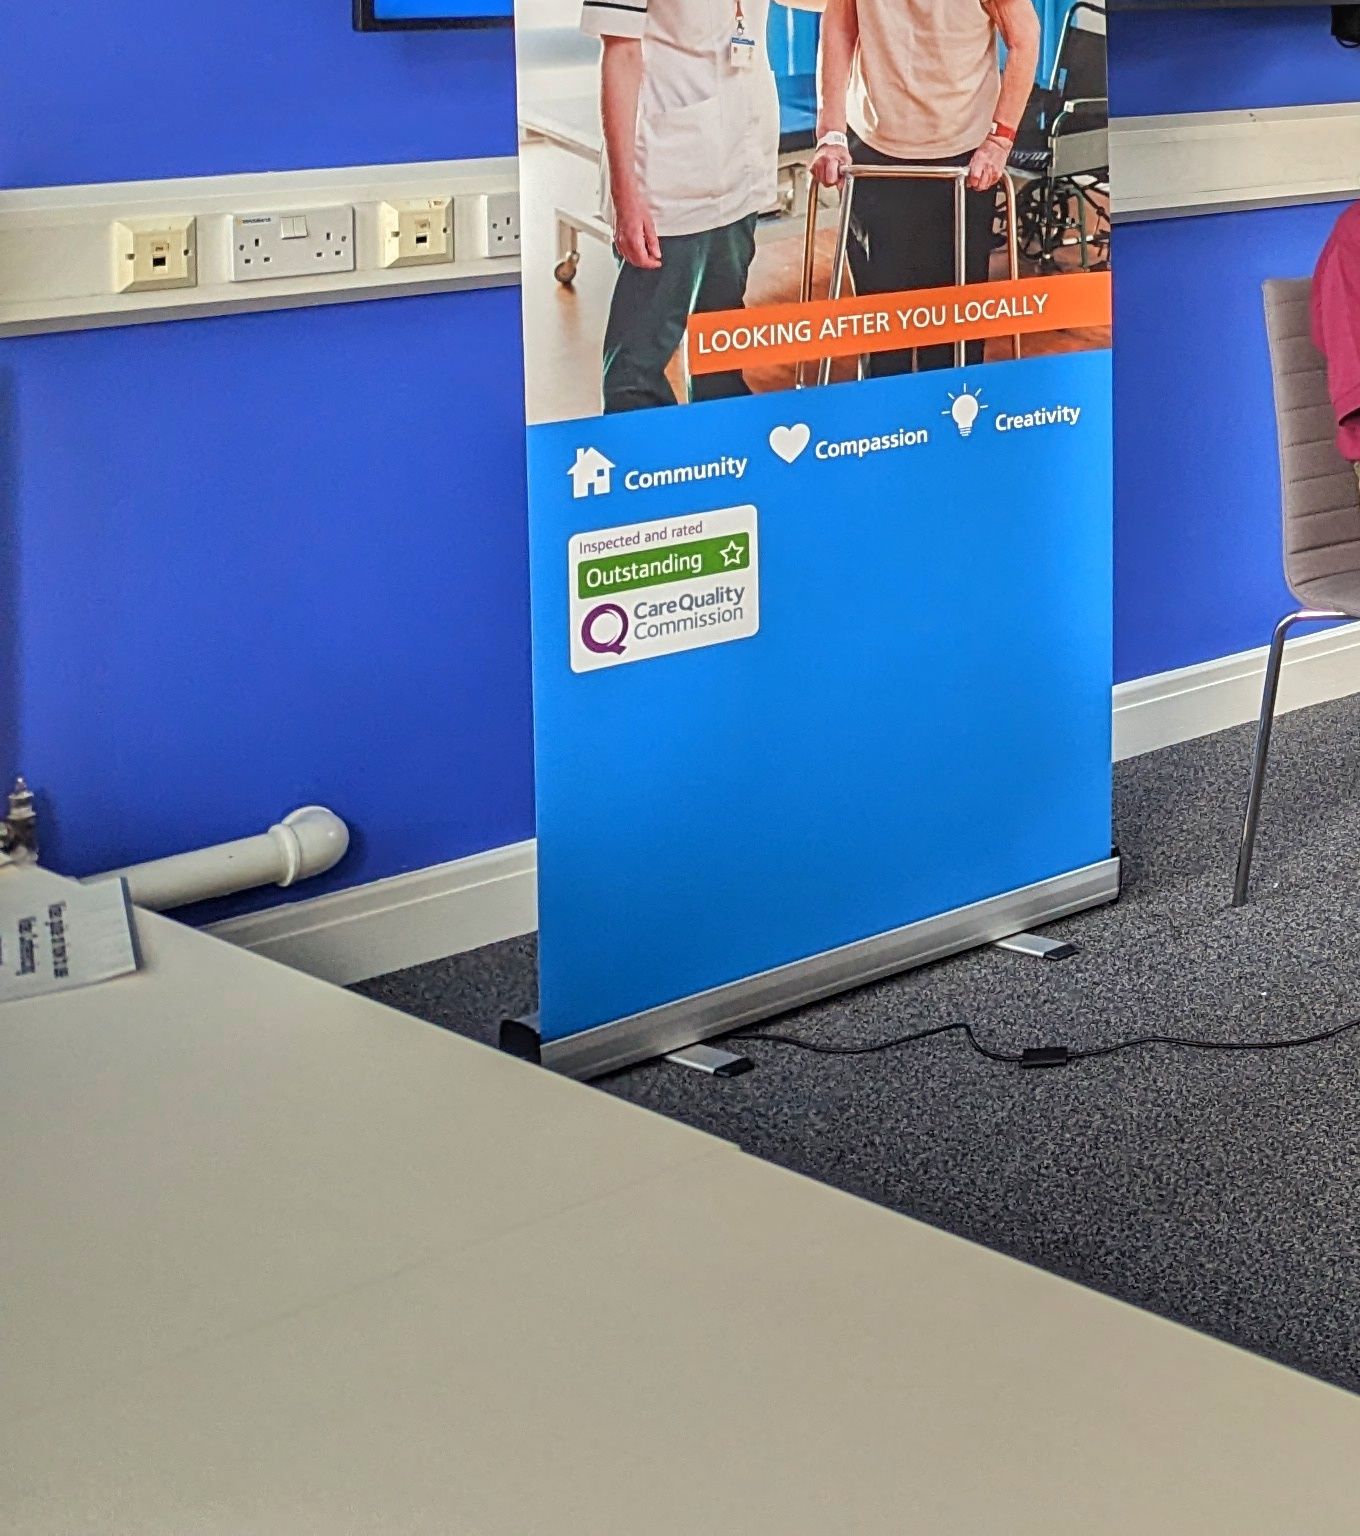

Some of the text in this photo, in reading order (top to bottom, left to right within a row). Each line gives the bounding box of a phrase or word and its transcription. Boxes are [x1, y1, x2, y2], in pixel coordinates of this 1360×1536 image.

[697, 293, 1049, 355] LOOKING AFTER YOU LOCALLY
[624, 404, 1081, 491] Community Compassion Creativity
[578, 520, 704, 556] Inspected and rated
[585, 548, 703, 589] Outstanding
[633, 603, 744, 641] Commission
